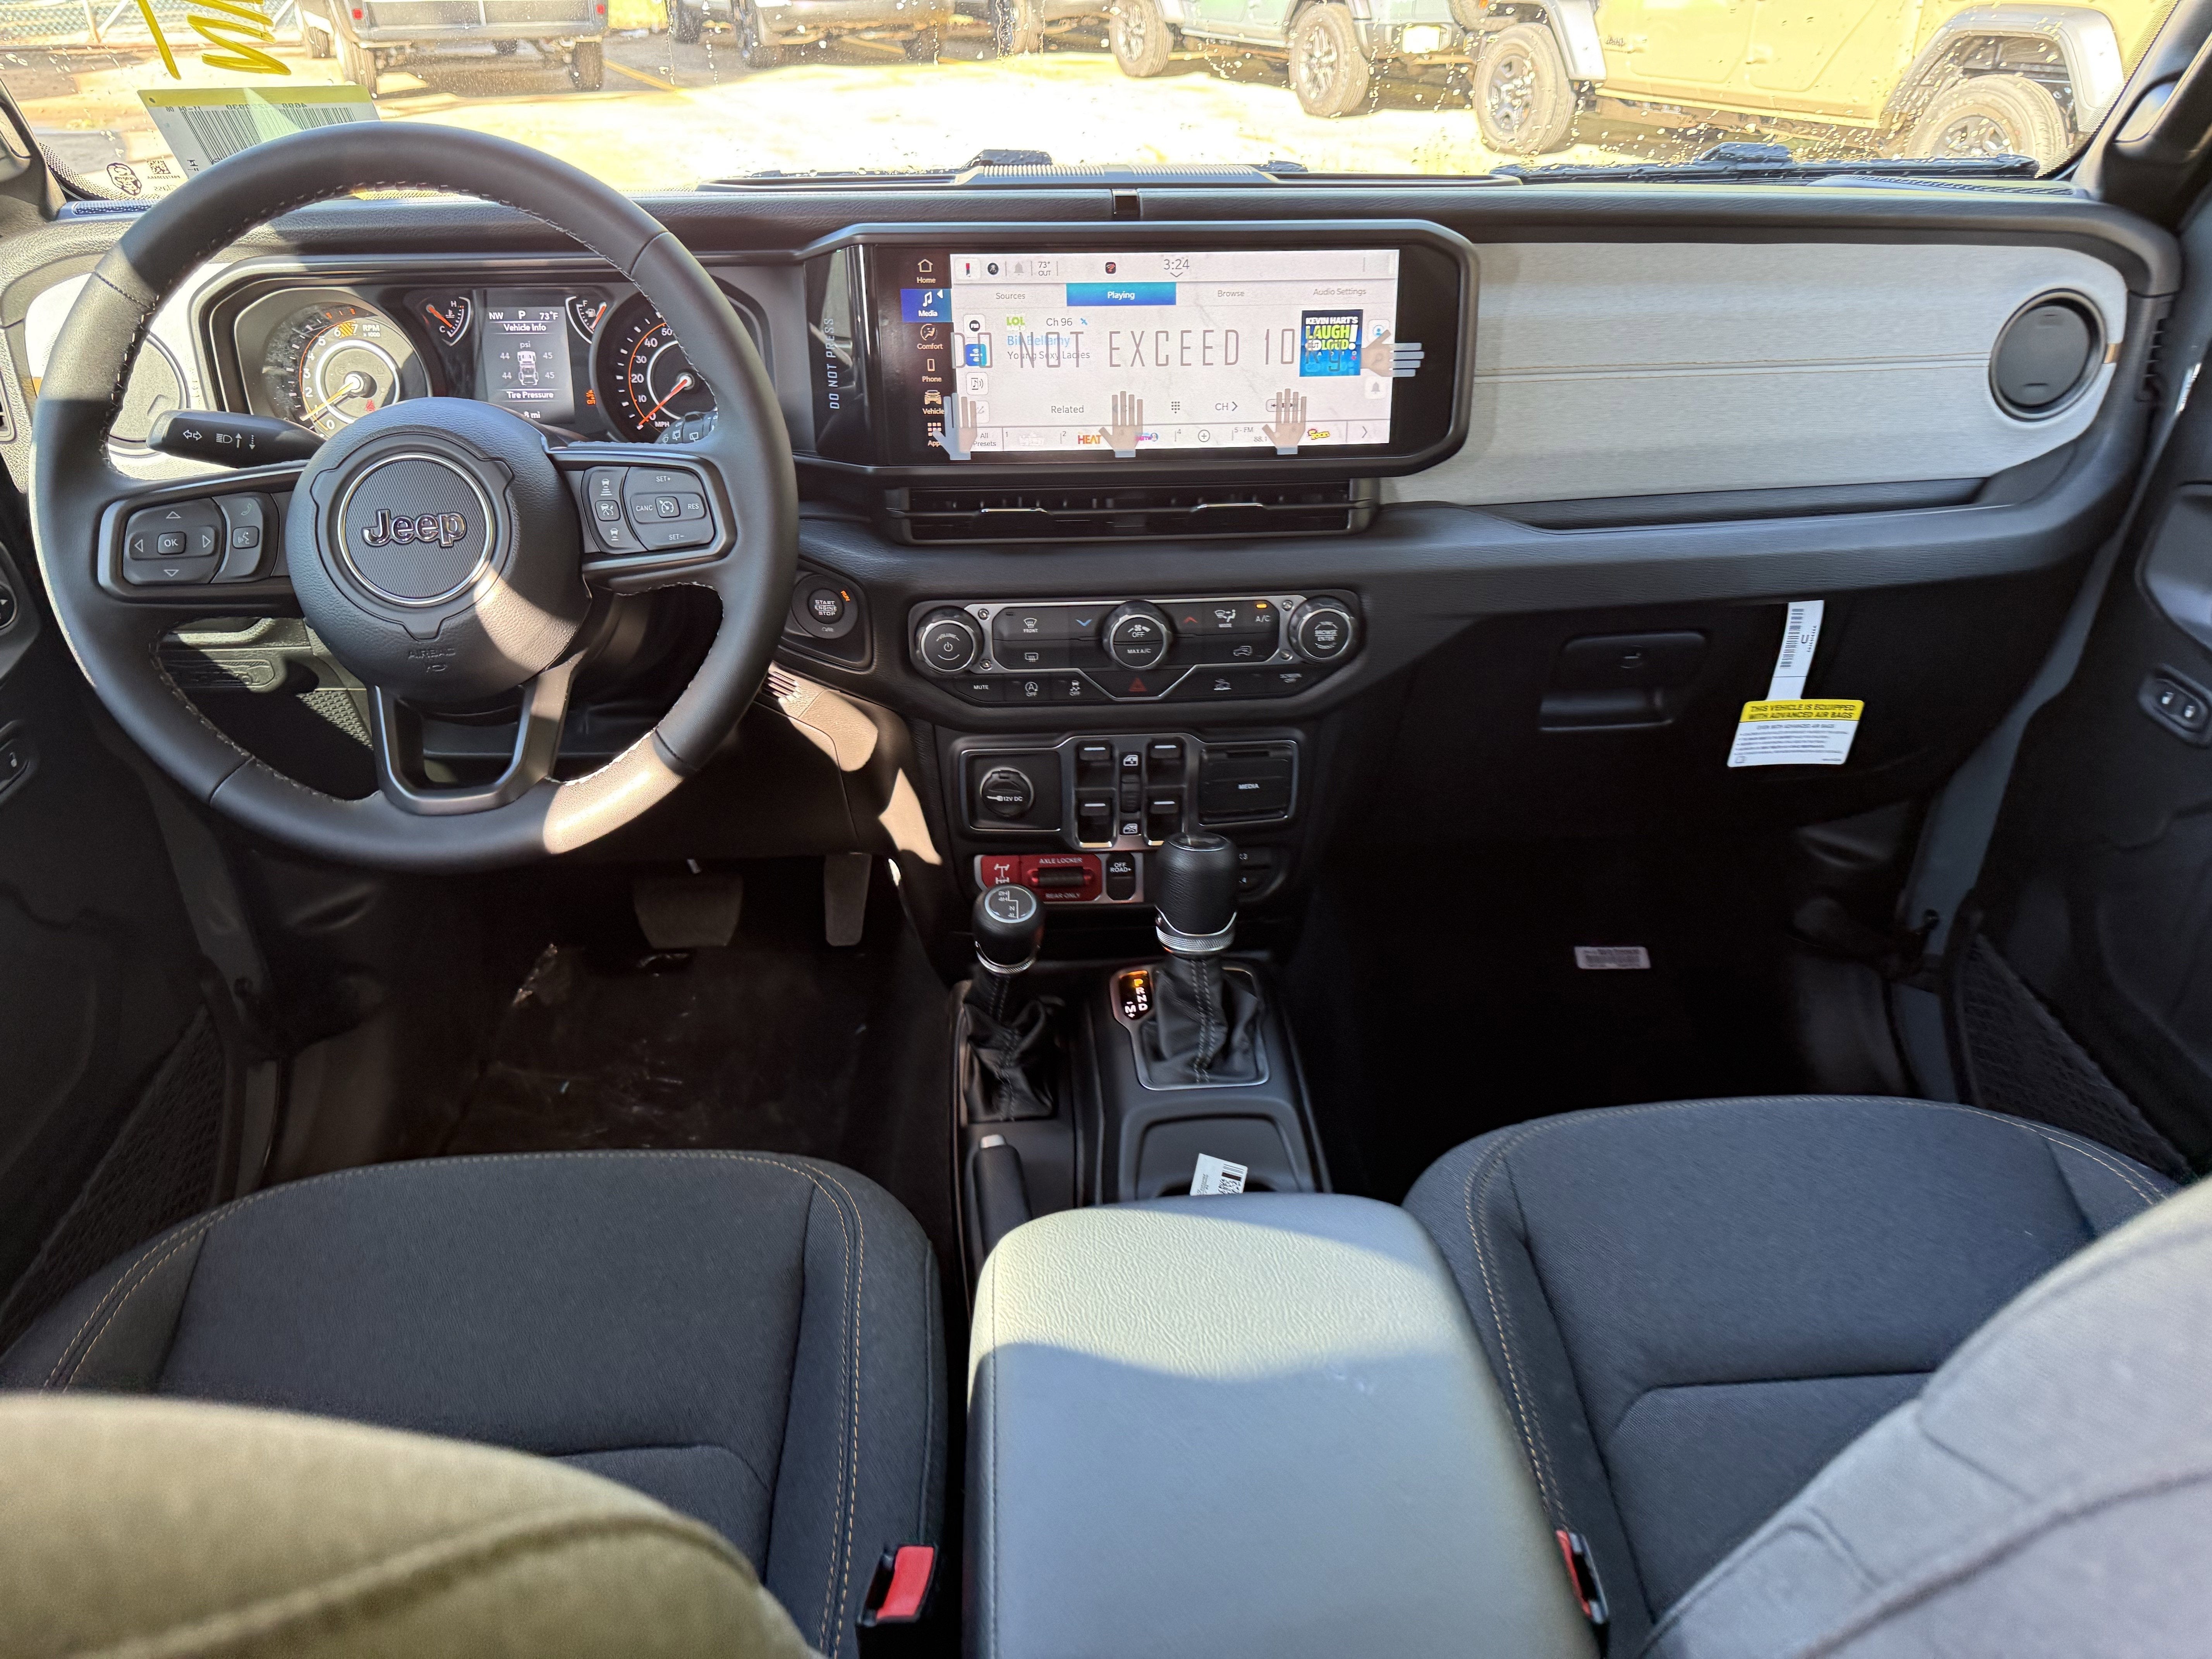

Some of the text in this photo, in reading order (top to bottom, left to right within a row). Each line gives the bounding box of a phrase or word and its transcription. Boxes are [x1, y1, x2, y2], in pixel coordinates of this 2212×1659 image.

[1163, 258, 1190, 270] 3:24
[995, 292, 1026, 300] Sources
[1107, 291, 1135, 300] Playing
[1336, 288, 1367, 296] Settings
[519, 311, 526, 320] P
[539, 311, 558, 320] 73°F
[1006, 316, 1025, 326] LOL
[1046, 318, 1073, 326] Ch 96
[333, 327, 341, 338] 6
[503, 323, 546, 332] Vehicle Info
[661, 328, 673, 336] 50
[318, 336, 326, 346] 5
[644, 338, 658, 348] 40
[1019, 331, 1084, 368] NOT
[1109, 329, 1239, 368] EXCEED
[307, 350, 315, 361] 4
[635, 355, 647, 364] 30
[824, 318, 840, 409] DO NOT PRESS
[303, 369, 311, 378] 3
[631, 373, 644, 383] 20
[305, 388, 313, 398] 2
[522, 391, 554, 399] Pressure
[1050, 404, 1084, 414] Related
[326, 419, 335, 430] 0
[1077, 434, 1102, 445] HEAT
[362, 508, 467, 548] Jeep
[164, 538, 178, 548] OK
[1135, 987, 1146, 995] R
[1137, 994, 1147, 1003] N
[1124, 1003, 1148, 1013] M D
